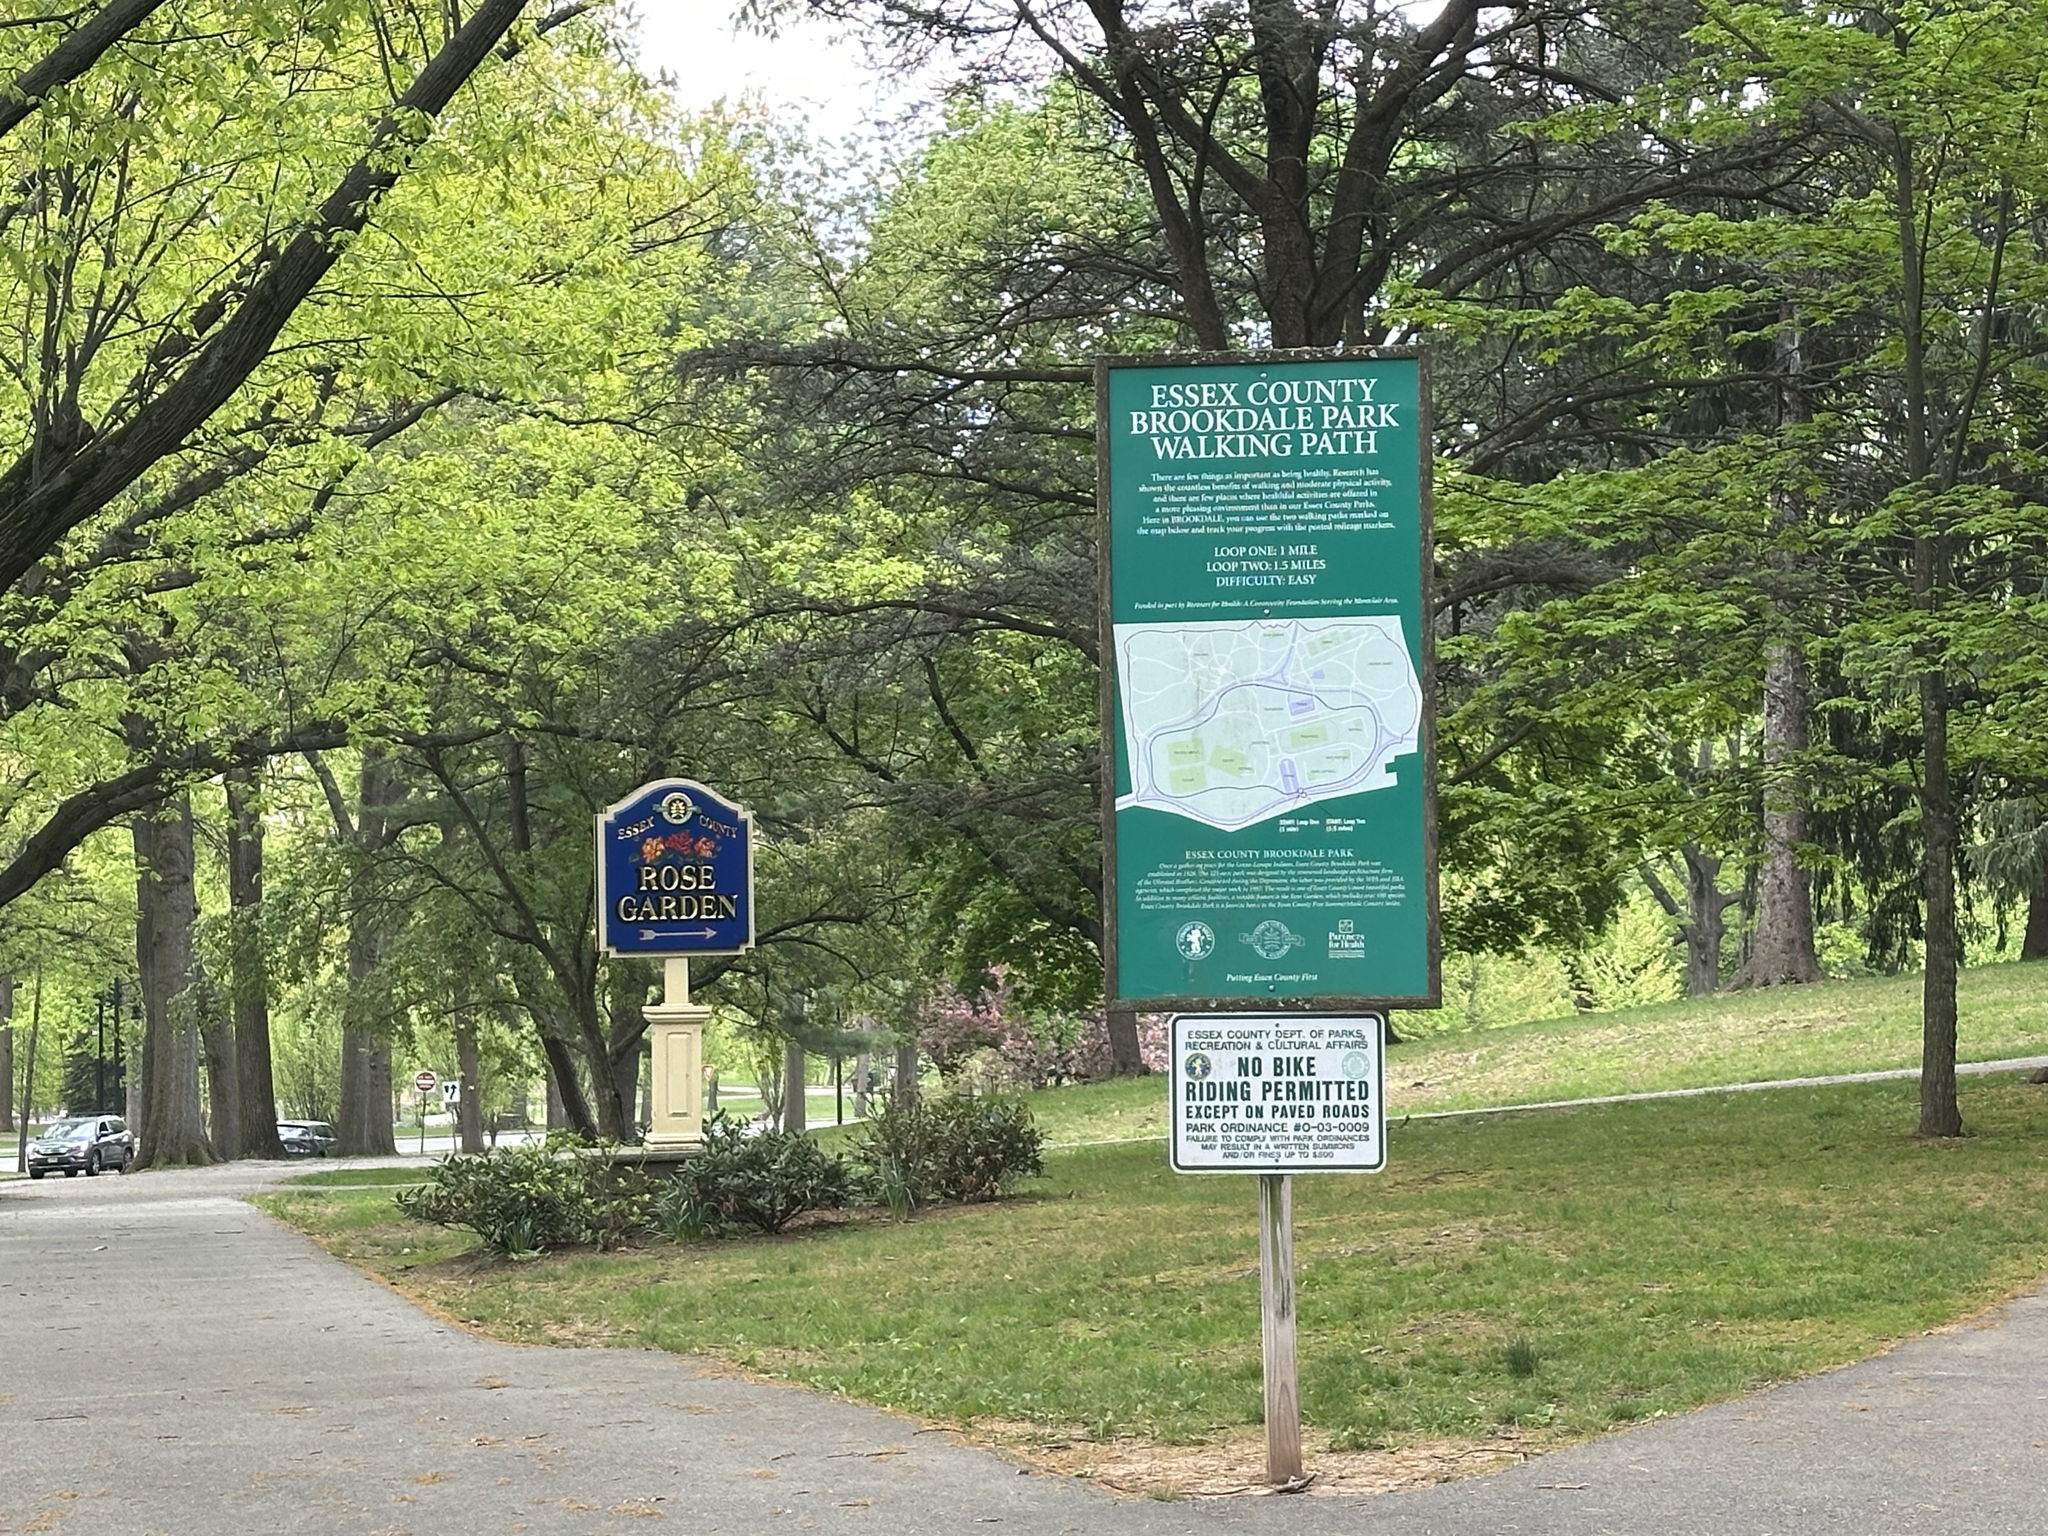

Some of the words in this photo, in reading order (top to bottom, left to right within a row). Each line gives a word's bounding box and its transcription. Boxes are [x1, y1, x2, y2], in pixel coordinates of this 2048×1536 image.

[1151, 382, 1238, 408] ESSEX
[1247, 378, 1377, 405] COUNTY
[1130, 407, 1314, 435] BROOKDALE
[1322, 403, 1400, 430] PARK
[1150, 434, 1292, 460] WALKING
[1301, 430, 1378, 456] PATH
[1214, 547, 1246, 557] LOOP
[1248, 546, 1276, 556] ONE:
[1281, 546, 1284, 555] 1
[1288, 545, 1318, 555] MILE
[1206, 562, 1238, 572] LOOP
[1240, 561, 1272, 571] TWO:
[1274, 560, 1288, 570] 1.5
[1290, 560, 1326, 570] MILES
[1216, 576, 1285, 587] DIFFICULTY:
[1288, 575, 1317, 585] EASY
[617, 817, 655, 840] ESSEX
[699, 815, 738, 838] COUNTY
[1185, 850, 1215, 860] ESSEX
[1217, 850, 1259, 859] COUNTY
[1263, 849, 1324, 858] BROOKDALE
[1328, 849, 1354, 857] PARK
[639, 865, 716, 890] ROSE
[618, 894, 738, 922] GARDEN
[1188, 1030, 1222, 1039] ESSEX
[1227, 1030, 1270, 1039] COUNTY
[1275, 1030, 1305, 1039] DEPT.
[1310, 1030, 1324, 1038] OF
[1328, 1029, 1365, 1040] PARKS,
[1185, 1041, 1251, 1050] RECREATION
[1255, 1041, 1263, 1050] &
[1268, 1040, 1321, 1050] CULTURAL
[1326, 1040, 1368, 1049] AFFAIRS
[1238, 1057, 1263, 1077] NO
[1273, 1057, 1316, 1076] BIKE
[1186, 1082, 1251, 1102] RIDING
[1262, 1081, 1369, 1101] PERMITTED
[1186, 1106, 1239, 1119] EXCEPT
[1246, 1106, 1264, 1119] ON
[1272, 1105, 1315, 1118] PAVED
[1323, 1105, 1369, 1118] ROADS
[1186, 1123, 1215, 1132] PARK
[1220, 1123, 1288, 1132] ORDINANCE
